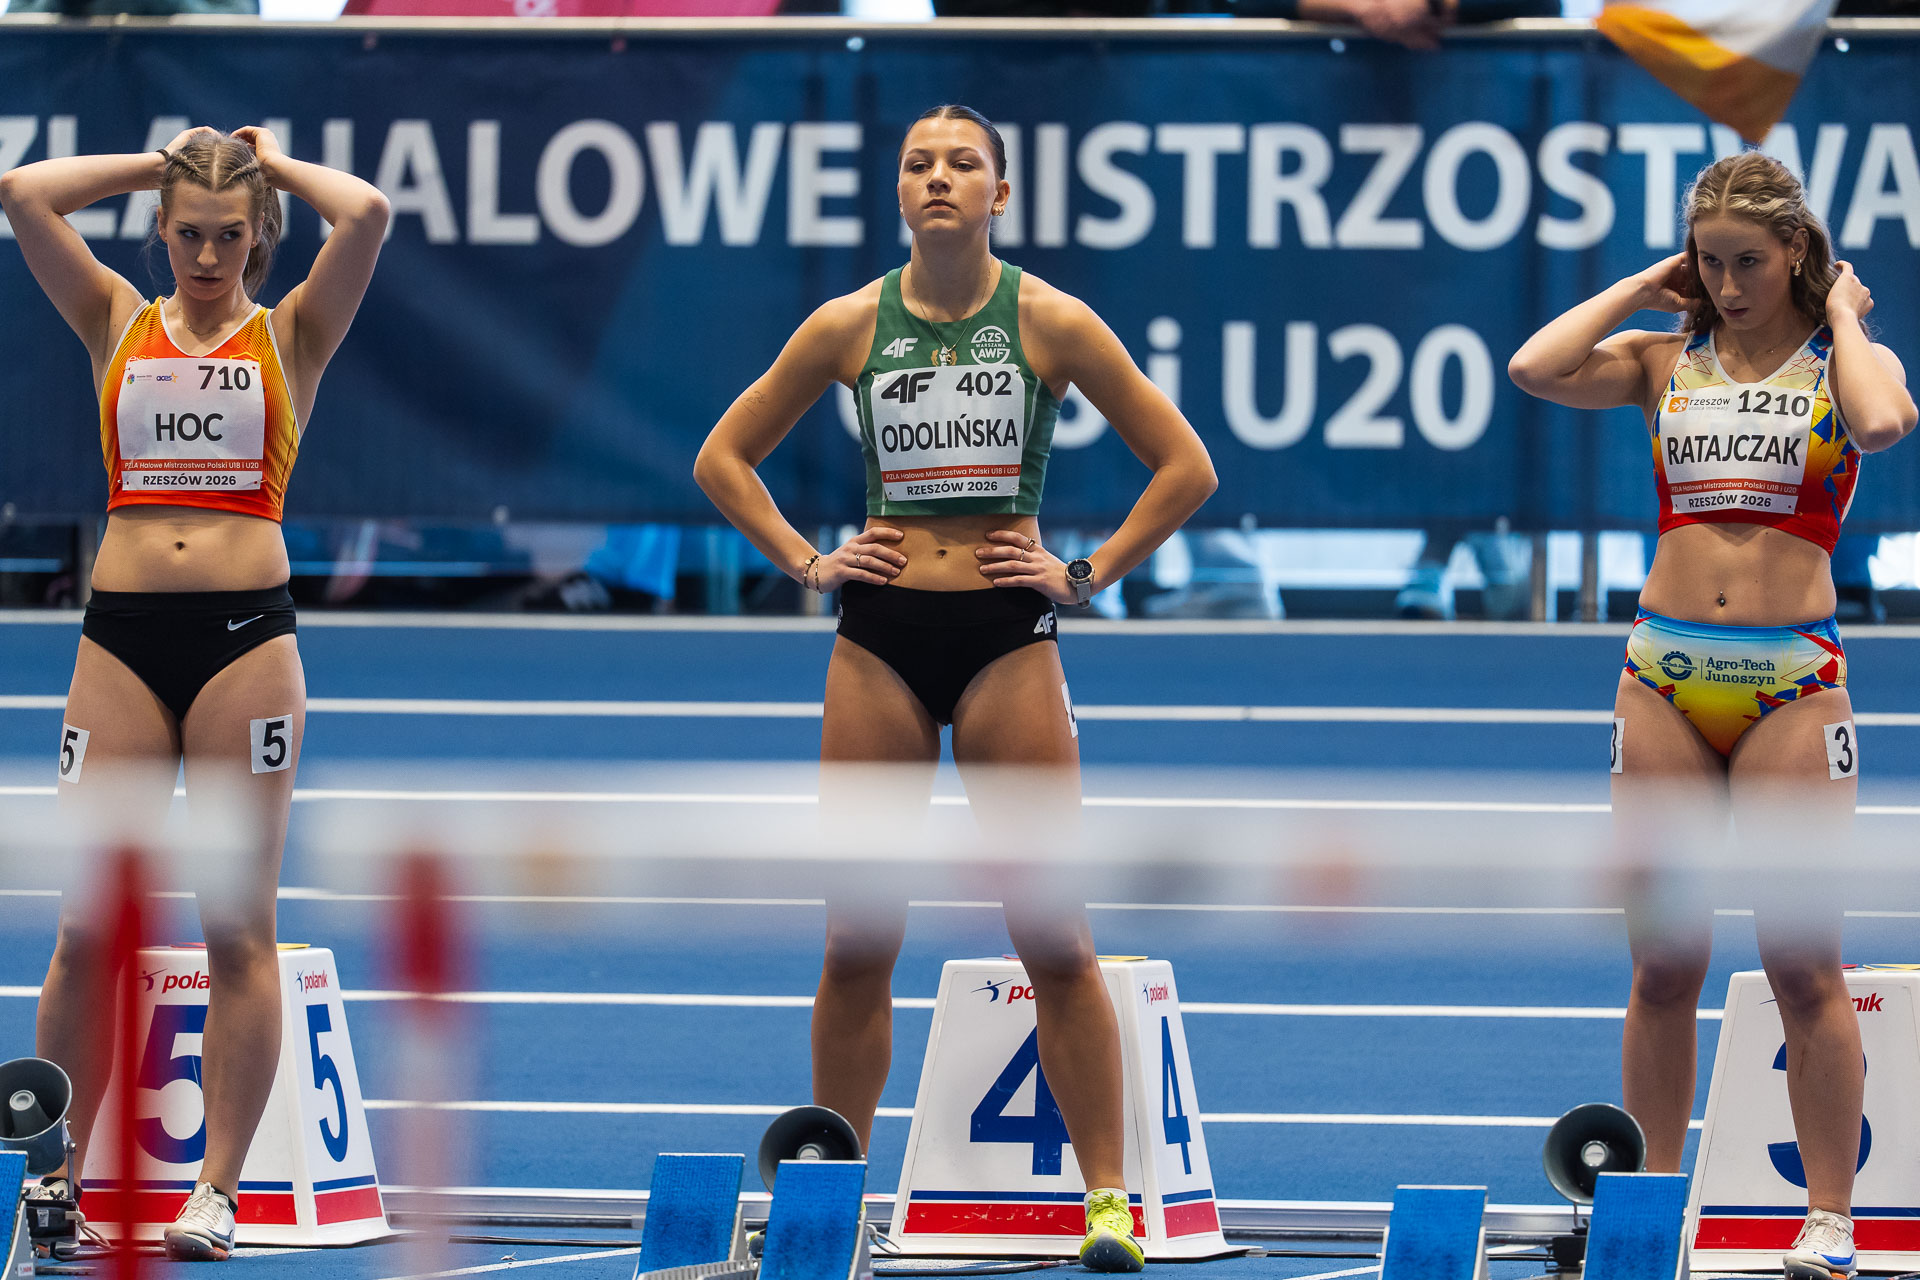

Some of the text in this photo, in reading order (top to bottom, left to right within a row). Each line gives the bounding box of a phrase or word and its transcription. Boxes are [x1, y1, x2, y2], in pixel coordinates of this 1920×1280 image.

[882, 338, 918, 358] 4F
[979, 332, 1002, 343] AZS
[978, 348, 1004, 359] AWF
[198, 366, 251, 391] 710
[881, 371, 936, 404] 4F
[955, 371, 1012, 397] 402
[1222, 321, 1496, 451] U20
[1737, 389, 1810, 417] 1210
[155, 413, 224, 442] HOC
[881, 413, 1019, 453] ODOLIŃSKA
[1667, 434, 1801, 466] RATAJCZAK
[124, 462, 139, 470] PZLA
[163, 461, 206, 469] Mistrzostwa
[207, 461, 228, 469] Polski
[885, 473, 900, 481] PZLA
[900, 471, 925, 479] Halowe
[925, 469, 967, 478] Mistrzostwa
[968, 467, 990, 475] Polski
[991, 467, 1002, 475] U18
[142, 473, 237, 486] RZESZÓW 2026
[907, 480, 998, 496] RZESZÓW 2026
[1703, 481, 1742, 489] Mistrzostwa
[1743, 481, 1766, 490] Polski
[1766, 484, 1779, 492] U18
[1783, 486, 1798, 494] U20
[1688, 492, 1772, 508] RZESZÓW 2026
[1705, 656, 1776, 671] Agro-Tech
[1705, 670, 1776, 687] Junoszyn
[60, 729, 79, 776] 5
[263, 720, 287, 768] 5
[1834, 726, 1853, 774] 3
[161, 970, 210, 994] pola
[304, 970, 329, 993] polanik
[1149, 982, 1170, 1005] polanik
[133, 1004, 207, 1164] 5
[306, 1003, 349, 1163] 5
[1161, 1016, 1192, 1175] 4
[969, 1024, 1073, 1176] 4
